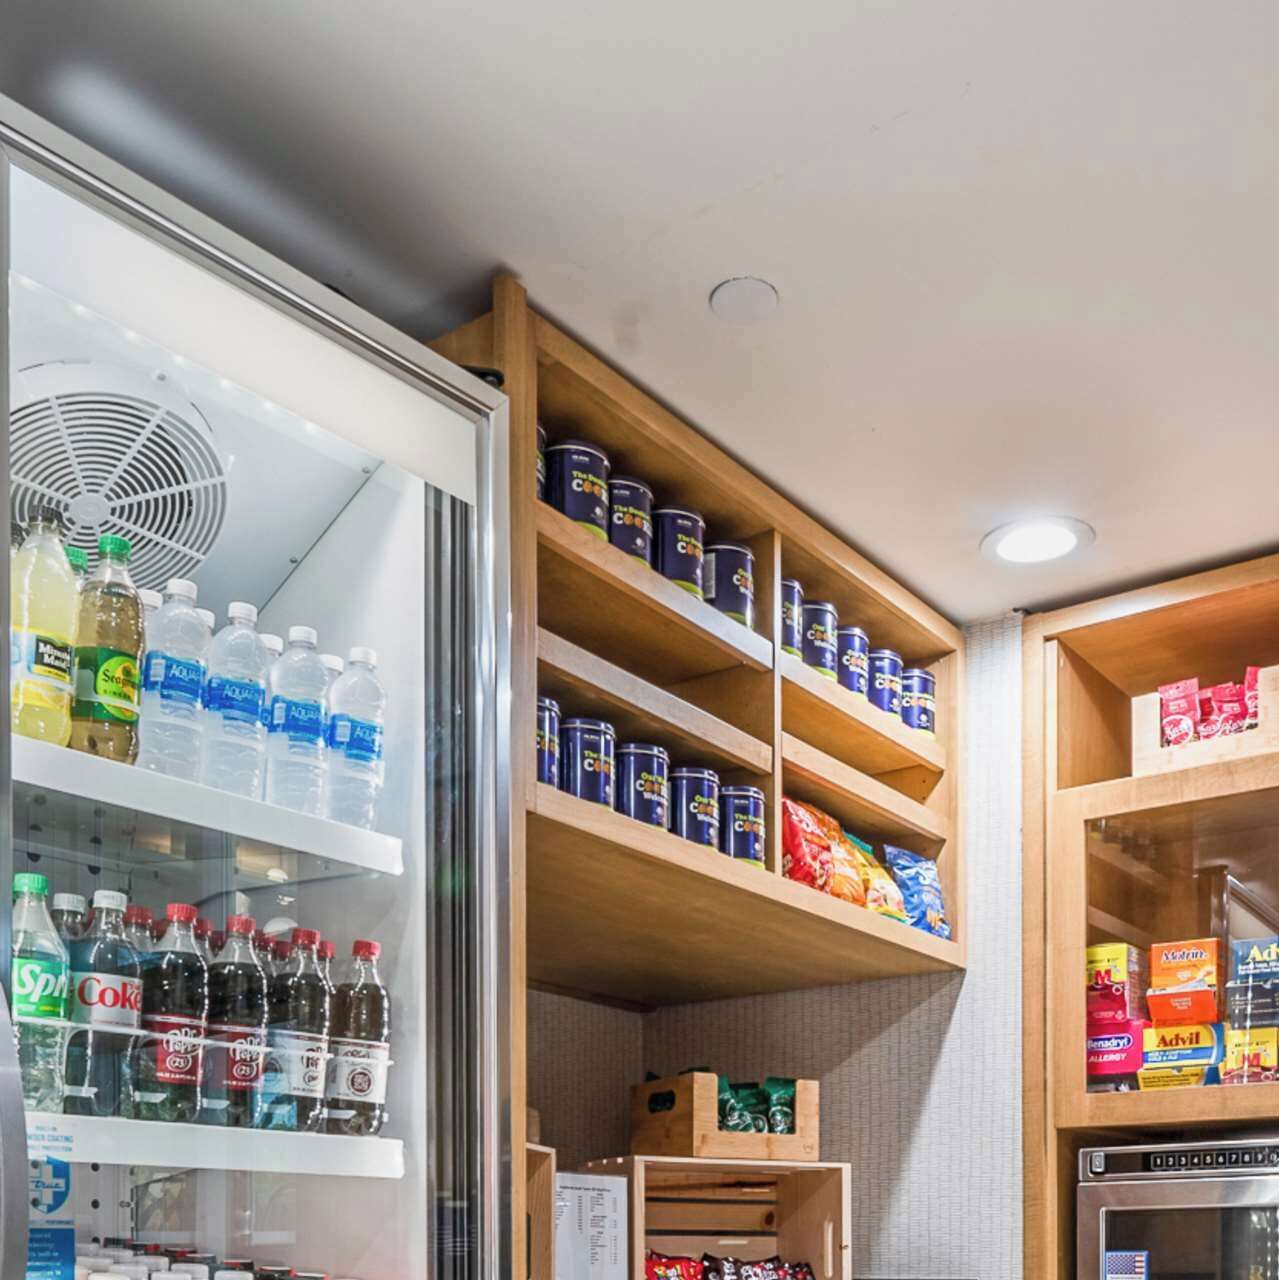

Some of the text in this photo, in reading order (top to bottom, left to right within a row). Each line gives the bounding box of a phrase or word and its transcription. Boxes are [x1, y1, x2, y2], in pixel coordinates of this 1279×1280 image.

[77, 976, 143, 1013] Coke
[1156, 1031, 1202, 1048] Advil
[1088, 1052, 1128, 1063] ALLERGY
